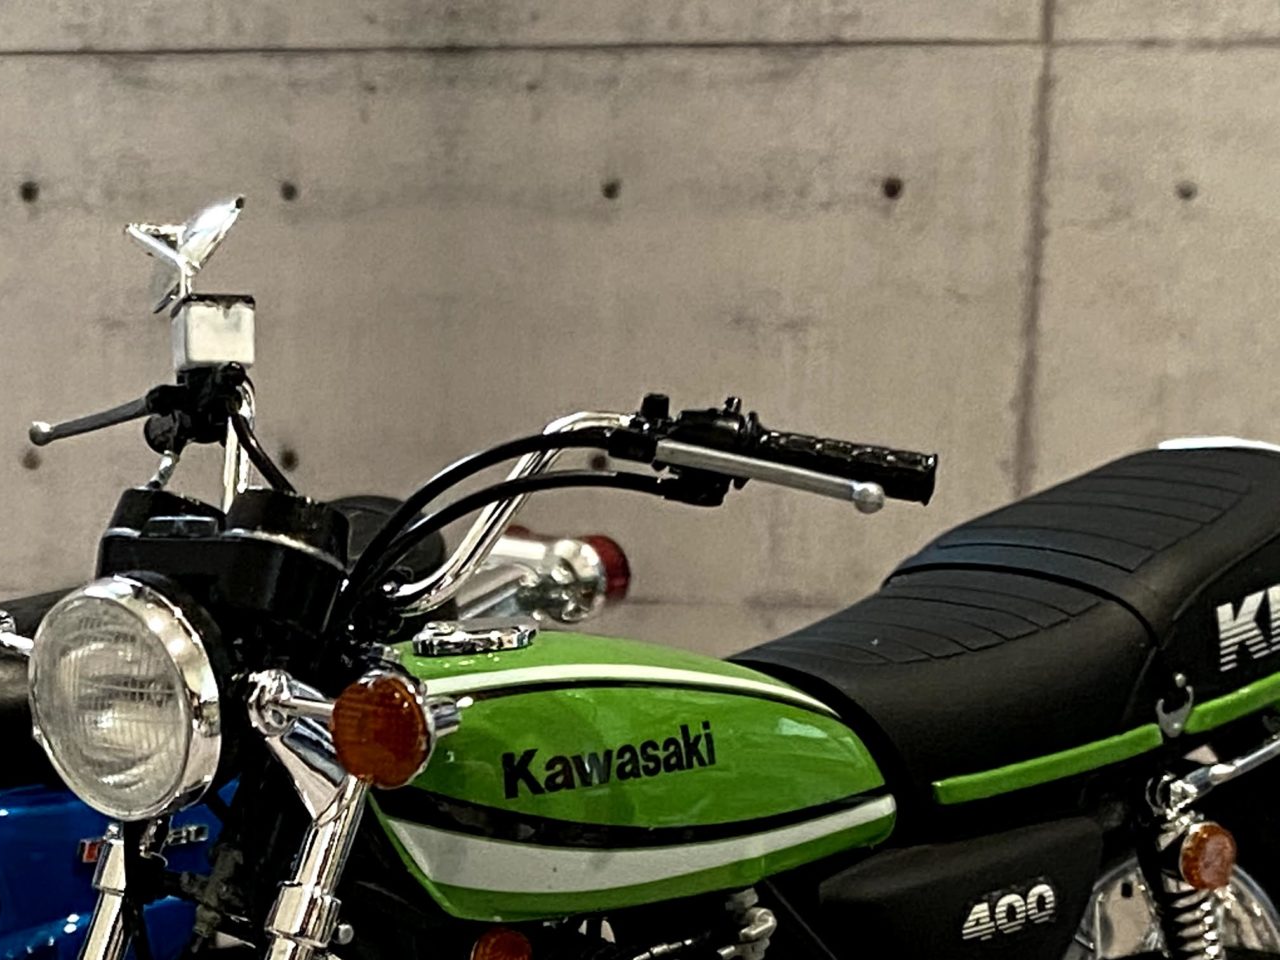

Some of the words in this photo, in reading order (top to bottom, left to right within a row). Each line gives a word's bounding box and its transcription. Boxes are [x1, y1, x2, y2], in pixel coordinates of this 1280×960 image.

[1216, 583, 1280, 672] K
[501, 720, 716, 799] Kawasaki
[962, 883, 1056, 940] 400
